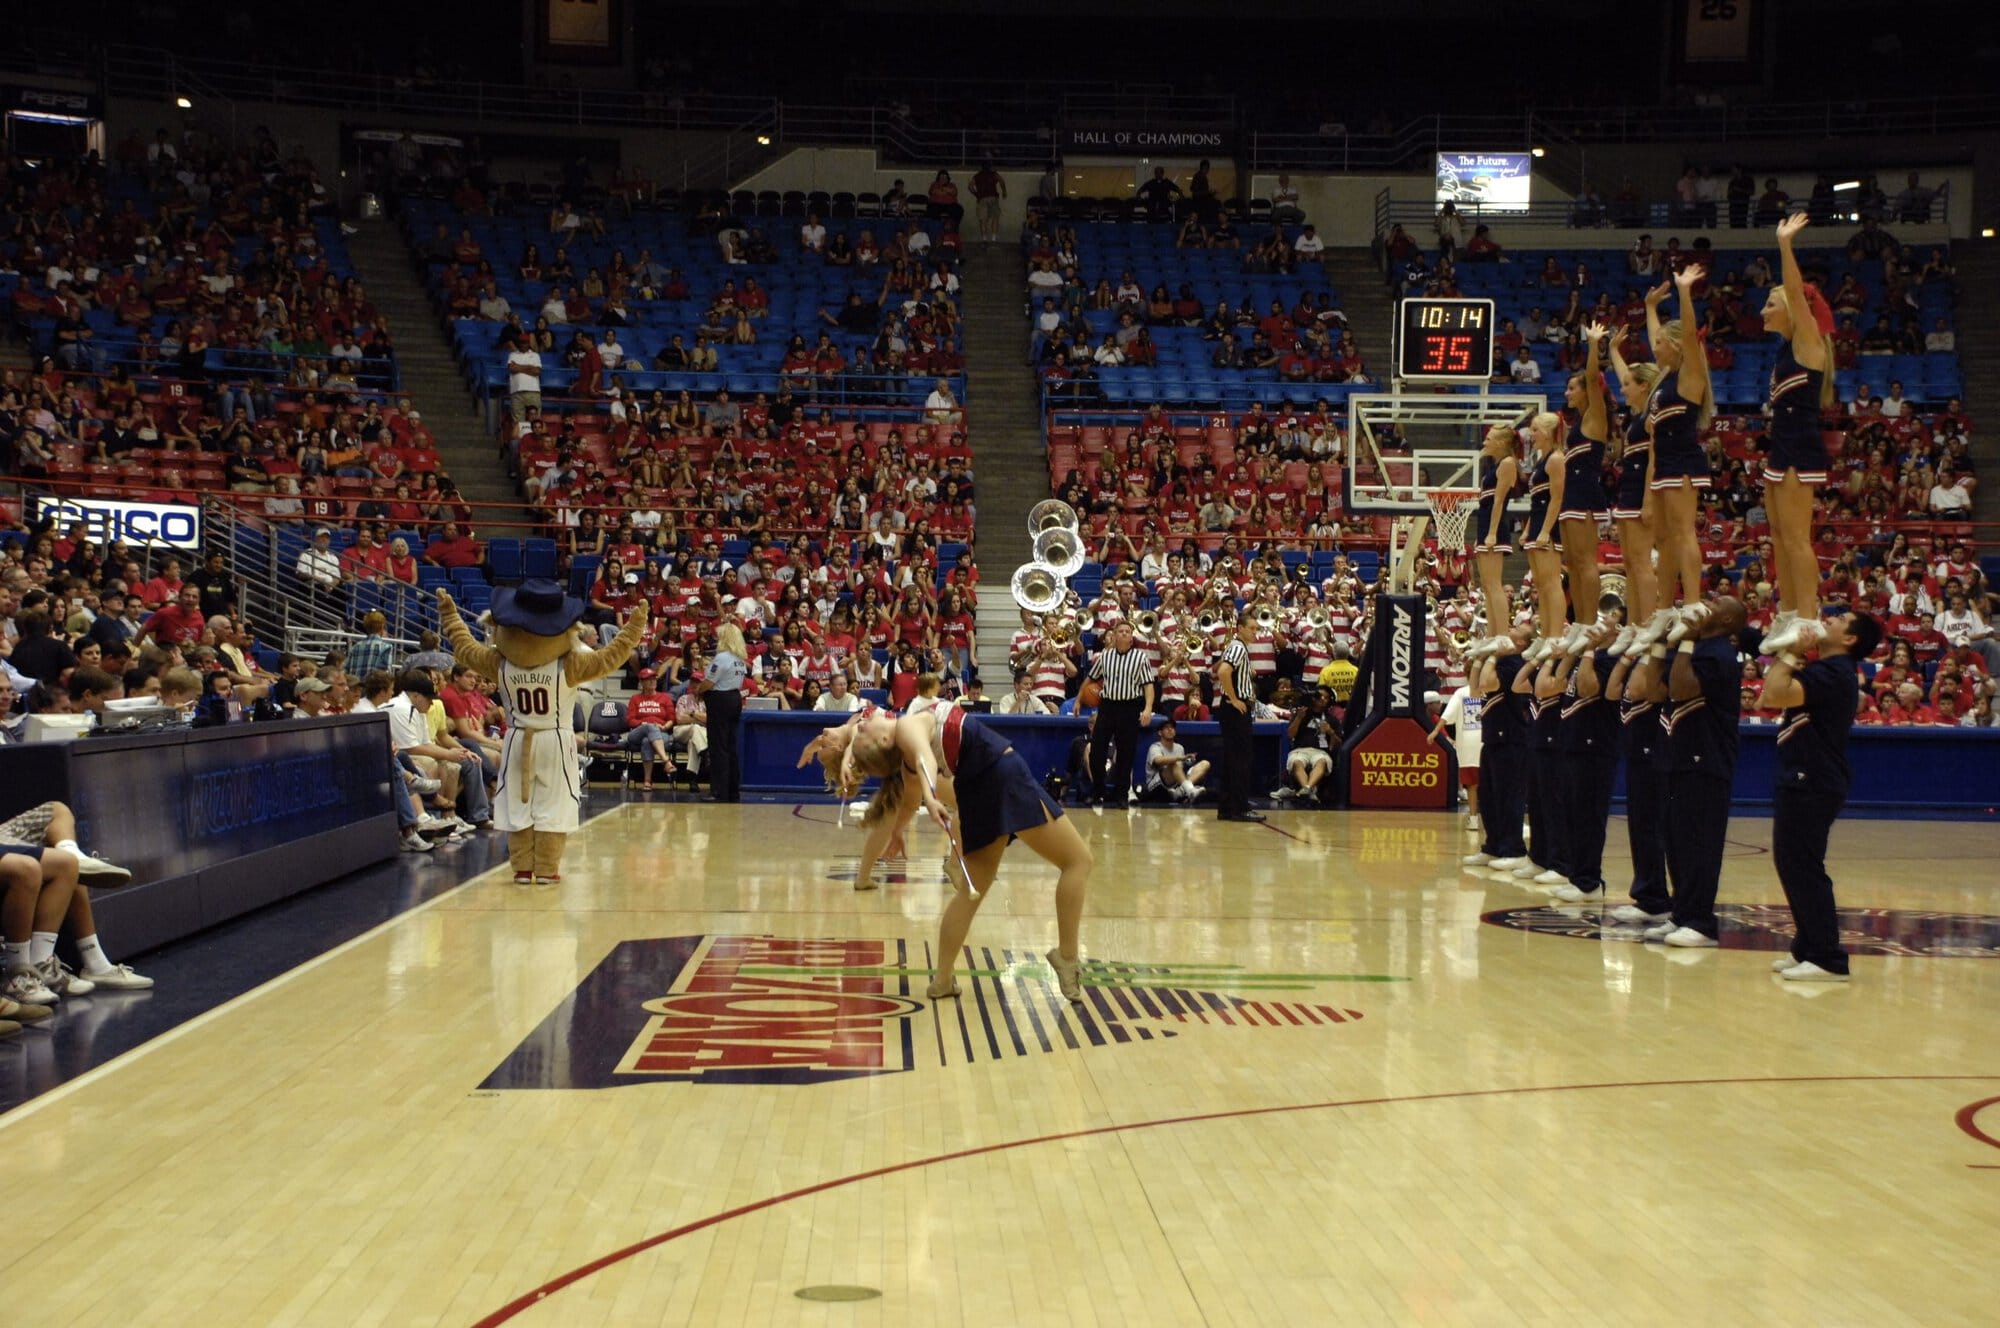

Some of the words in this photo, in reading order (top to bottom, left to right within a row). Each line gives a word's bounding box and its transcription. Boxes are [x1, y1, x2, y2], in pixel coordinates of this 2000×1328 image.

[21, 90, 88, 109] PEPSI
[1074, 132, 1110, 144] HALL
[1114, 132, 1131, 144] OF
[1137, 132, 1221, 145] CHAMPIONS
[1458, 155, 1475, 166] The
[1477, 155, 1509, 166] Future.
[1421, 306, 1483, 328] 10:14
[1423, 336, 1472, 370] 35
[170, 384, 183, 396] 19
[1213, 417, 1226, 428] 21
[1715, 420, 1730, 431] 22
[315, 502, 328, 514] 19
[43, 505, 195, 543] GEICO
[1947, 622, 1972, 632] ARIZONA
[1391, 604, 1412, 709] ARIZONA
[509, 673, 552, 686] WILBUR
[516, 687, 549, 715] 00
[1360, 752, 1439, 769] WELLS
[1362, 771, 1438, 787] FARGO
[632, 937, 902, 1072] ARIZONA
